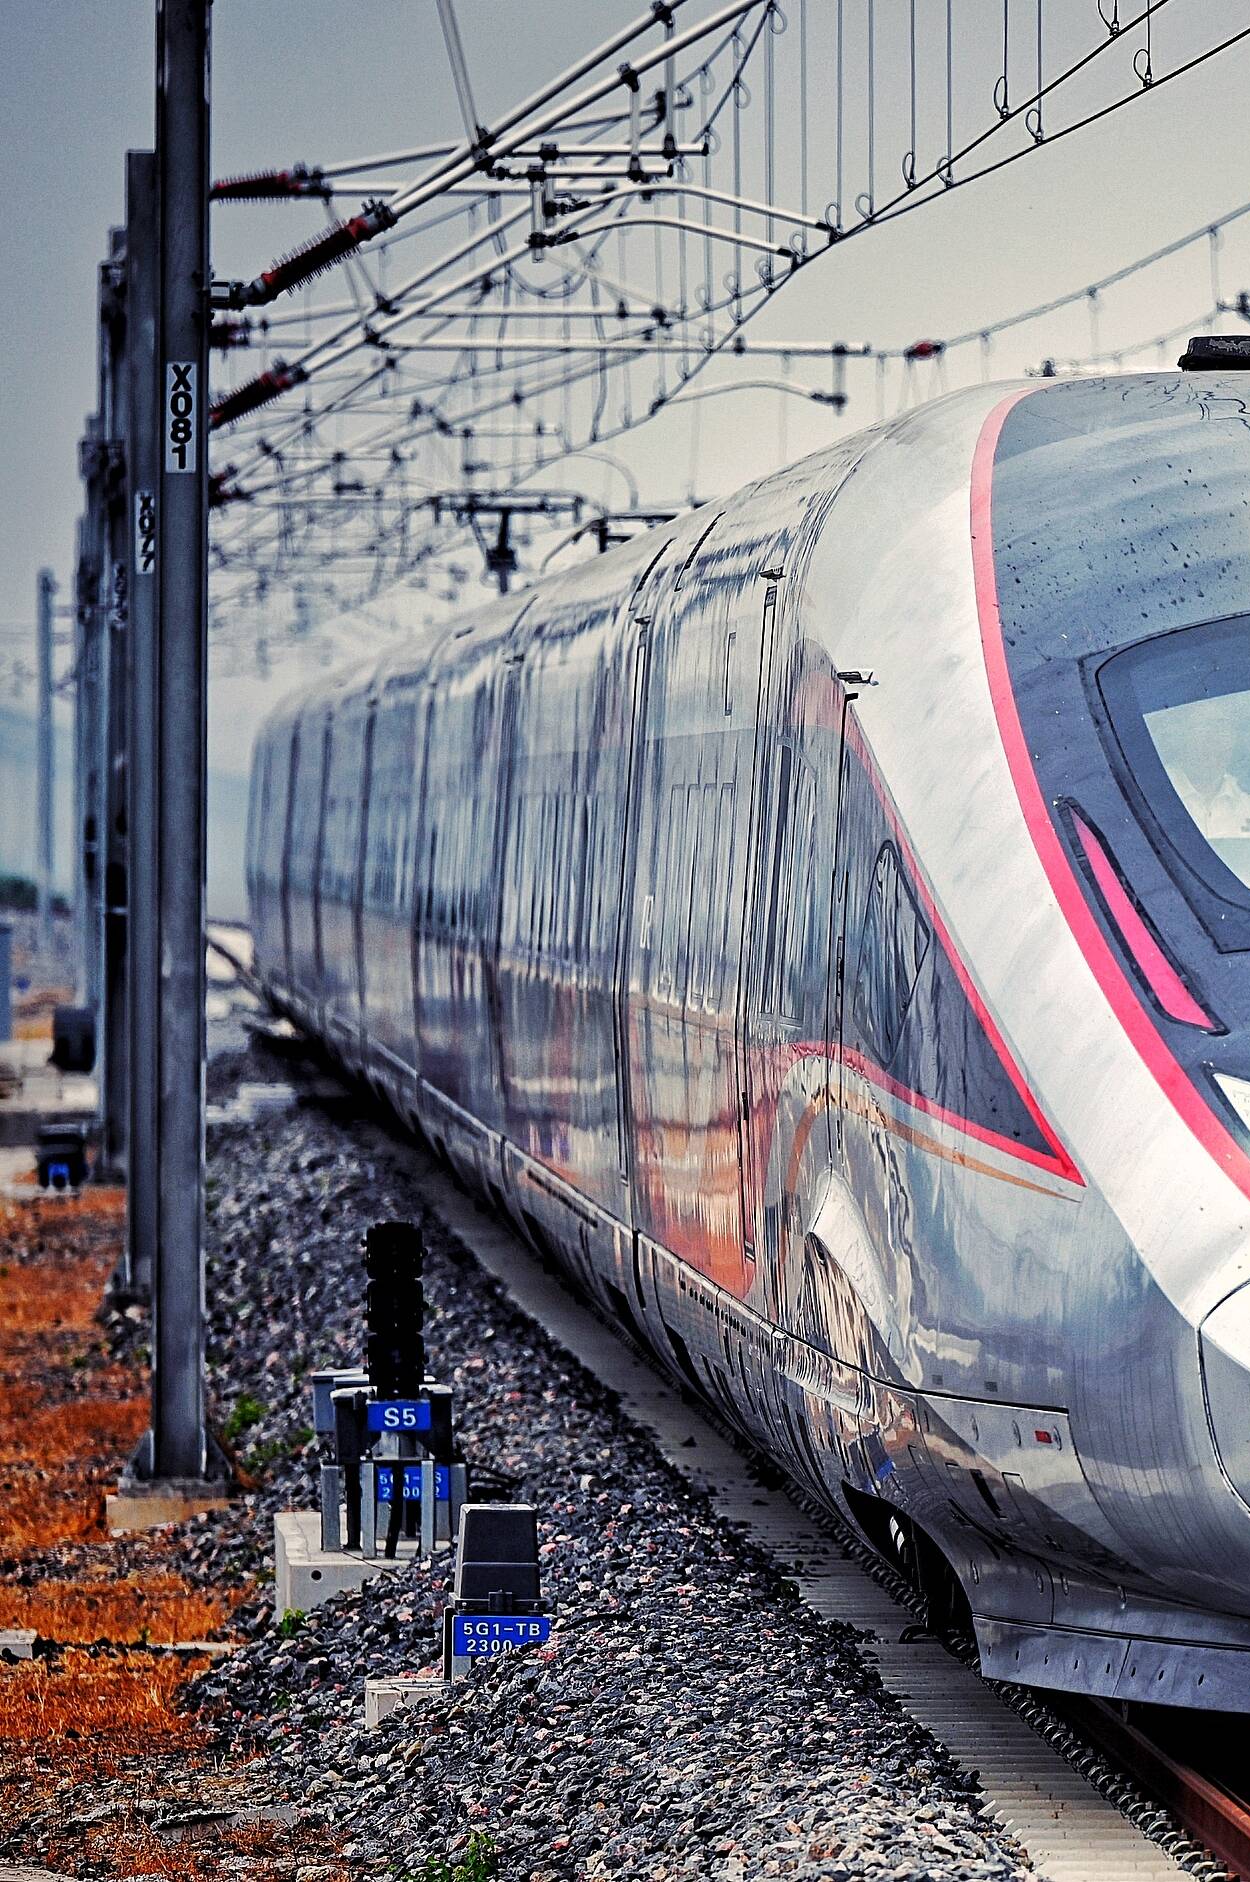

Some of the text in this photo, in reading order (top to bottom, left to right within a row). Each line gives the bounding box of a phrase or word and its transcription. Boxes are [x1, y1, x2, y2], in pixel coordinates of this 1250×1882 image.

[170, 364, 193, 470] X081
[384, 1406, 418, 1428] S5
[463, 1622, 541, 1637] 5G1-TB
